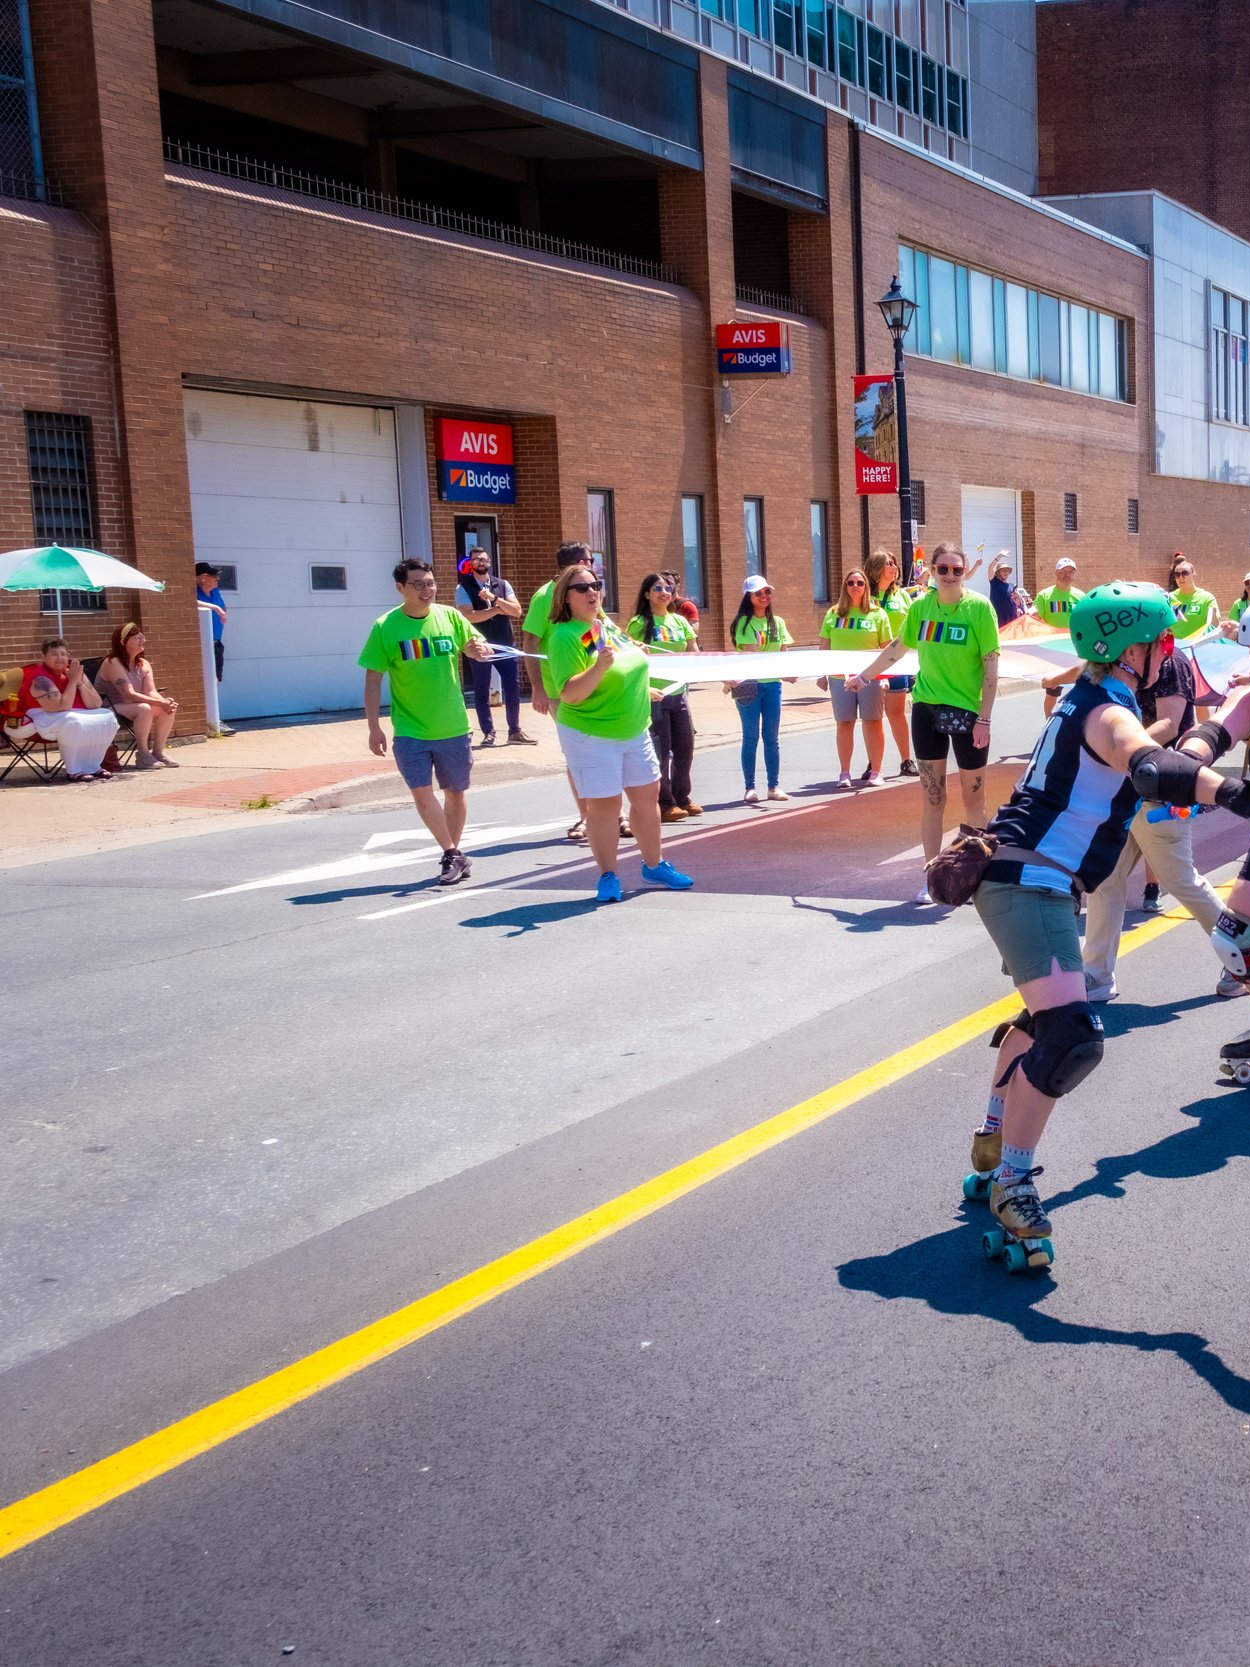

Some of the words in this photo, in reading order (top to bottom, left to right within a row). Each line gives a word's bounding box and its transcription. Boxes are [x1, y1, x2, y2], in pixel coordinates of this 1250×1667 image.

[732, 329, 766, 344] AVIS
[737, 352, 776, 367] Budget
[460, 431, 498, 455] AVIS
[862, 466, 892, 475] HAPPY
[467, 469, 511, 495] Budget
[863, 474, 891, 483] HERE!
[1094, 602, 1150, 638] Bex
[949, 626, 967, 641] TD
[434, 640, 453, 653] TD
[1220, 915, 1237, 930] 187
